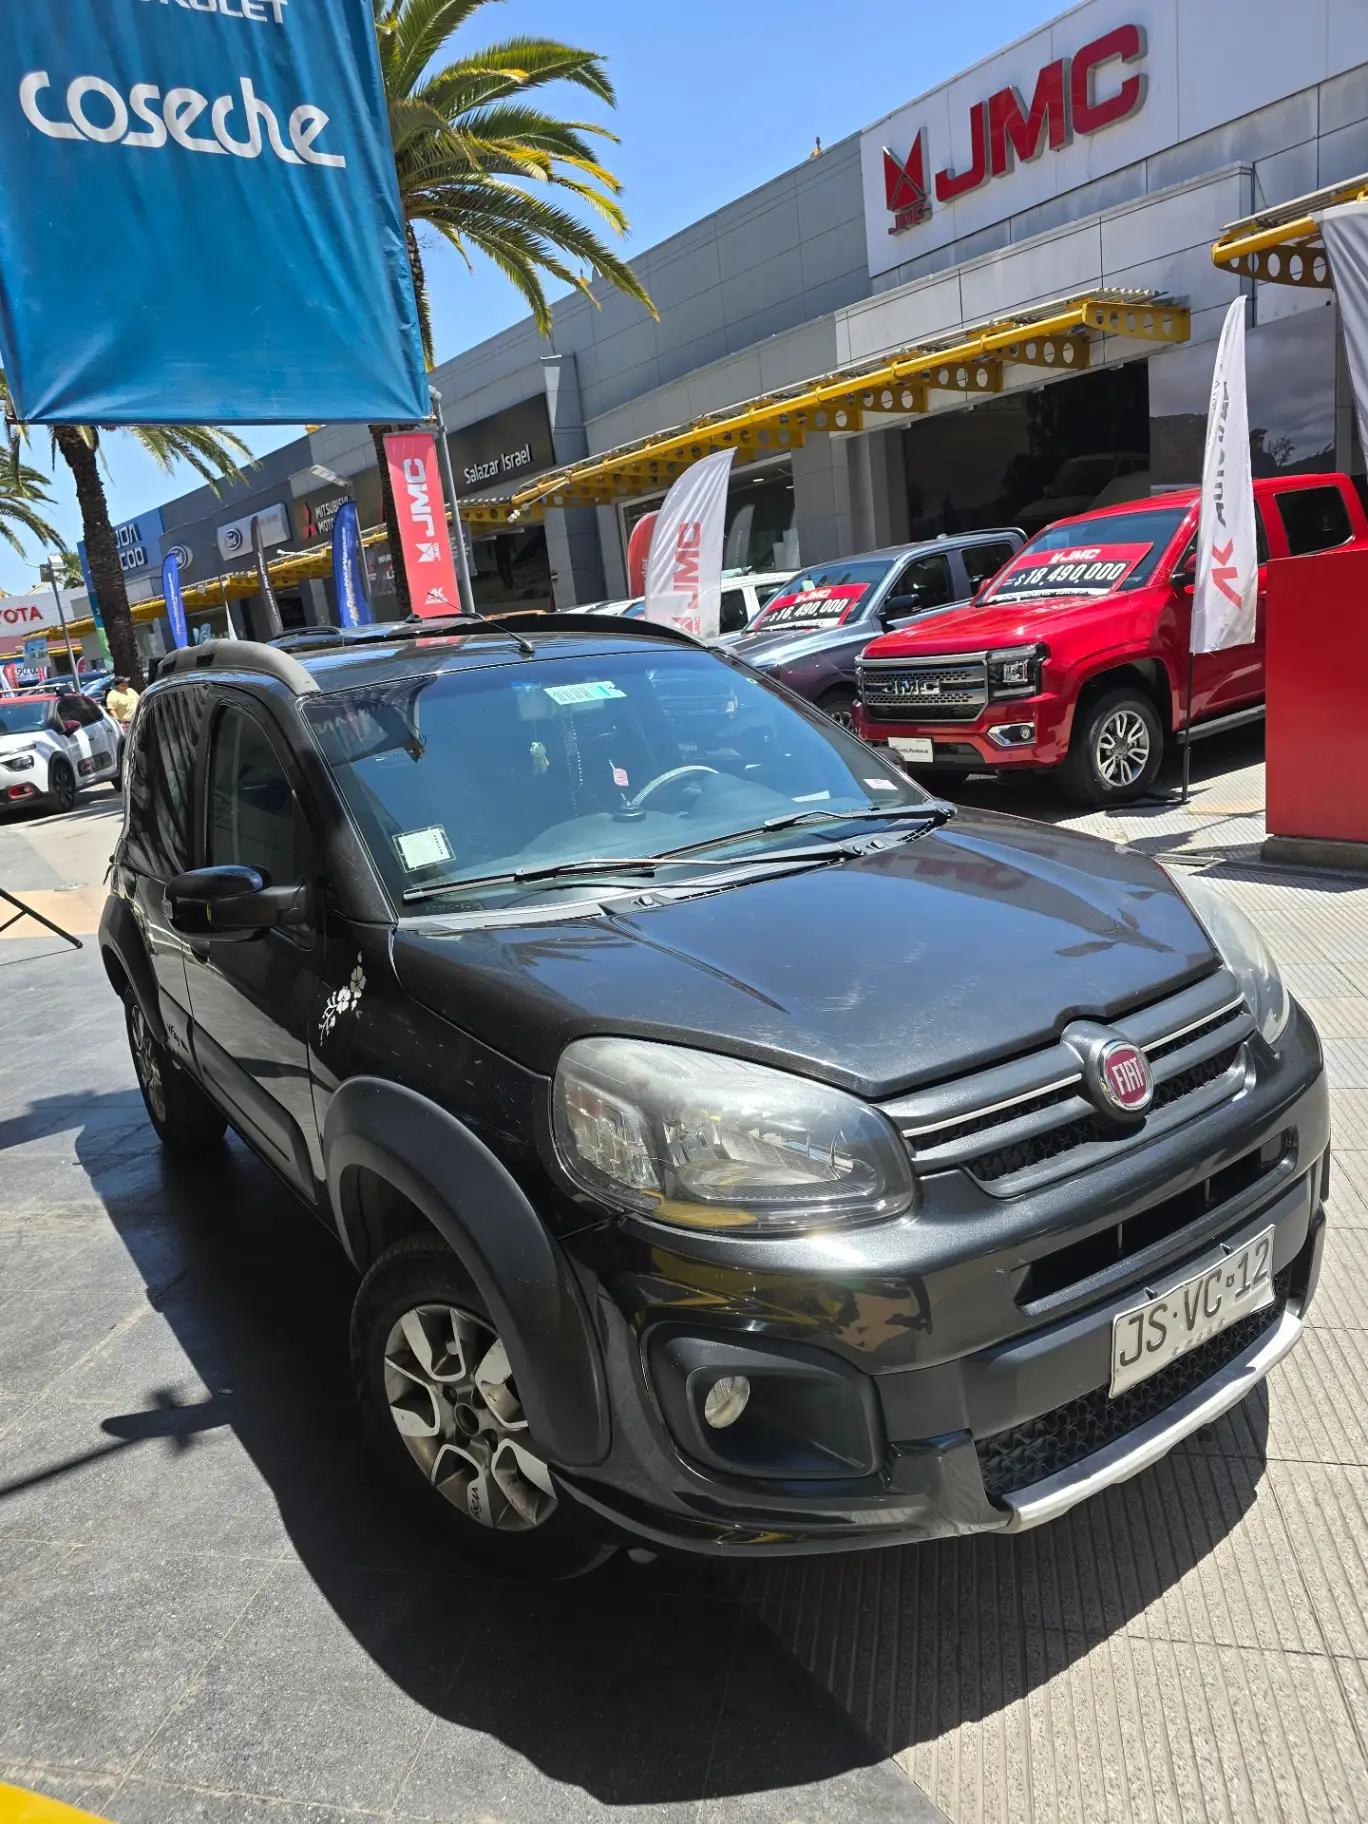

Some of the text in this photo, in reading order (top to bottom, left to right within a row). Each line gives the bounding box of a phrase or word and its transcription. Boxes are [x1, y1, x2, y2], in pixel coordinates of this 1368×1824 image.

[935, 24, 1147, 203] JMC
[463, 443, 531, 485] Salazar Israel
[403, 457, 436, 537] JMC
[672, 521, 702, 610] JMC
[1061, 549, 1101, 561] JMC
[1111, 1056, 1145, 1096] FIAT
